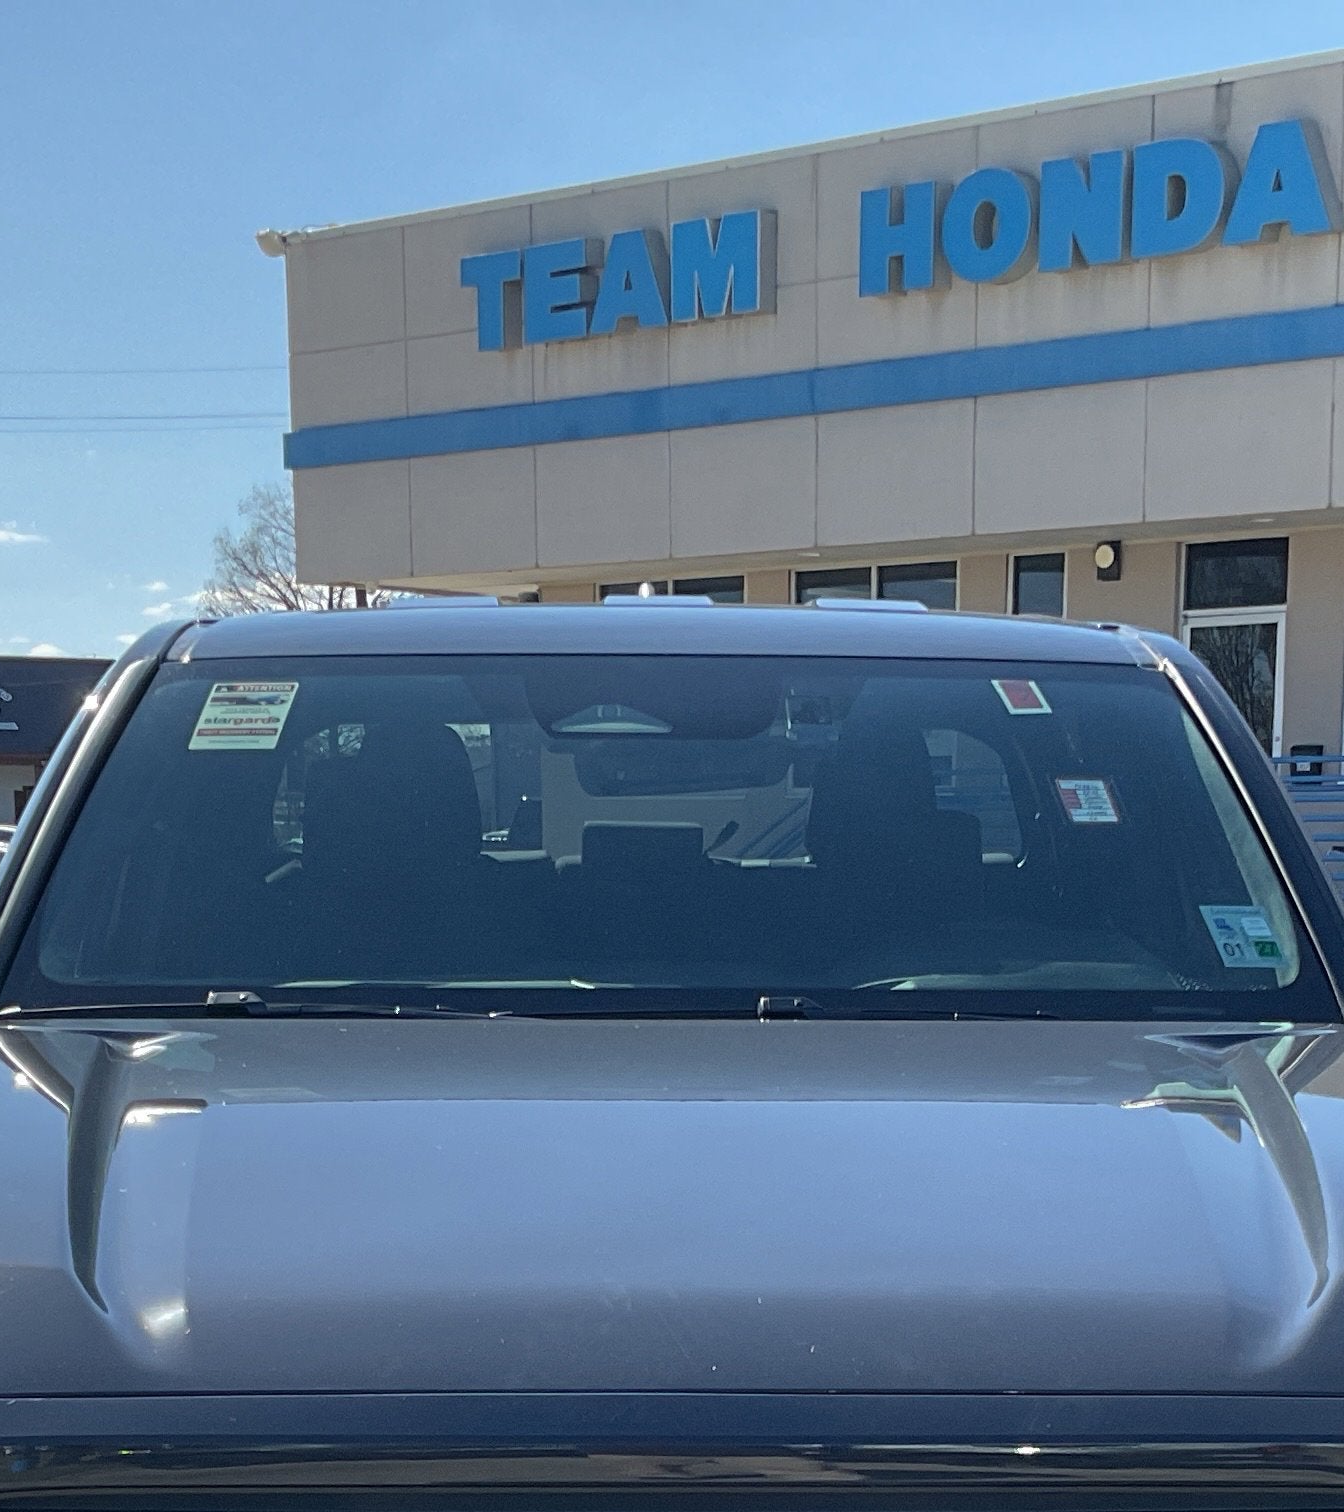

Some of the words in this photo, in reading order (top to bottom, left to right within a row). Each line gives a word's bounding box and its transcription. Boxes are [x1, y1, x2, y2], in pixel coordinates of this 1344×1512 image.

[460, 211, 760, 350] TEAM
[859, 119, 1331, 296] HONDA
[237, 685, 292, 693] ATTENTION
[1223, 942, 1245, 957] 01
